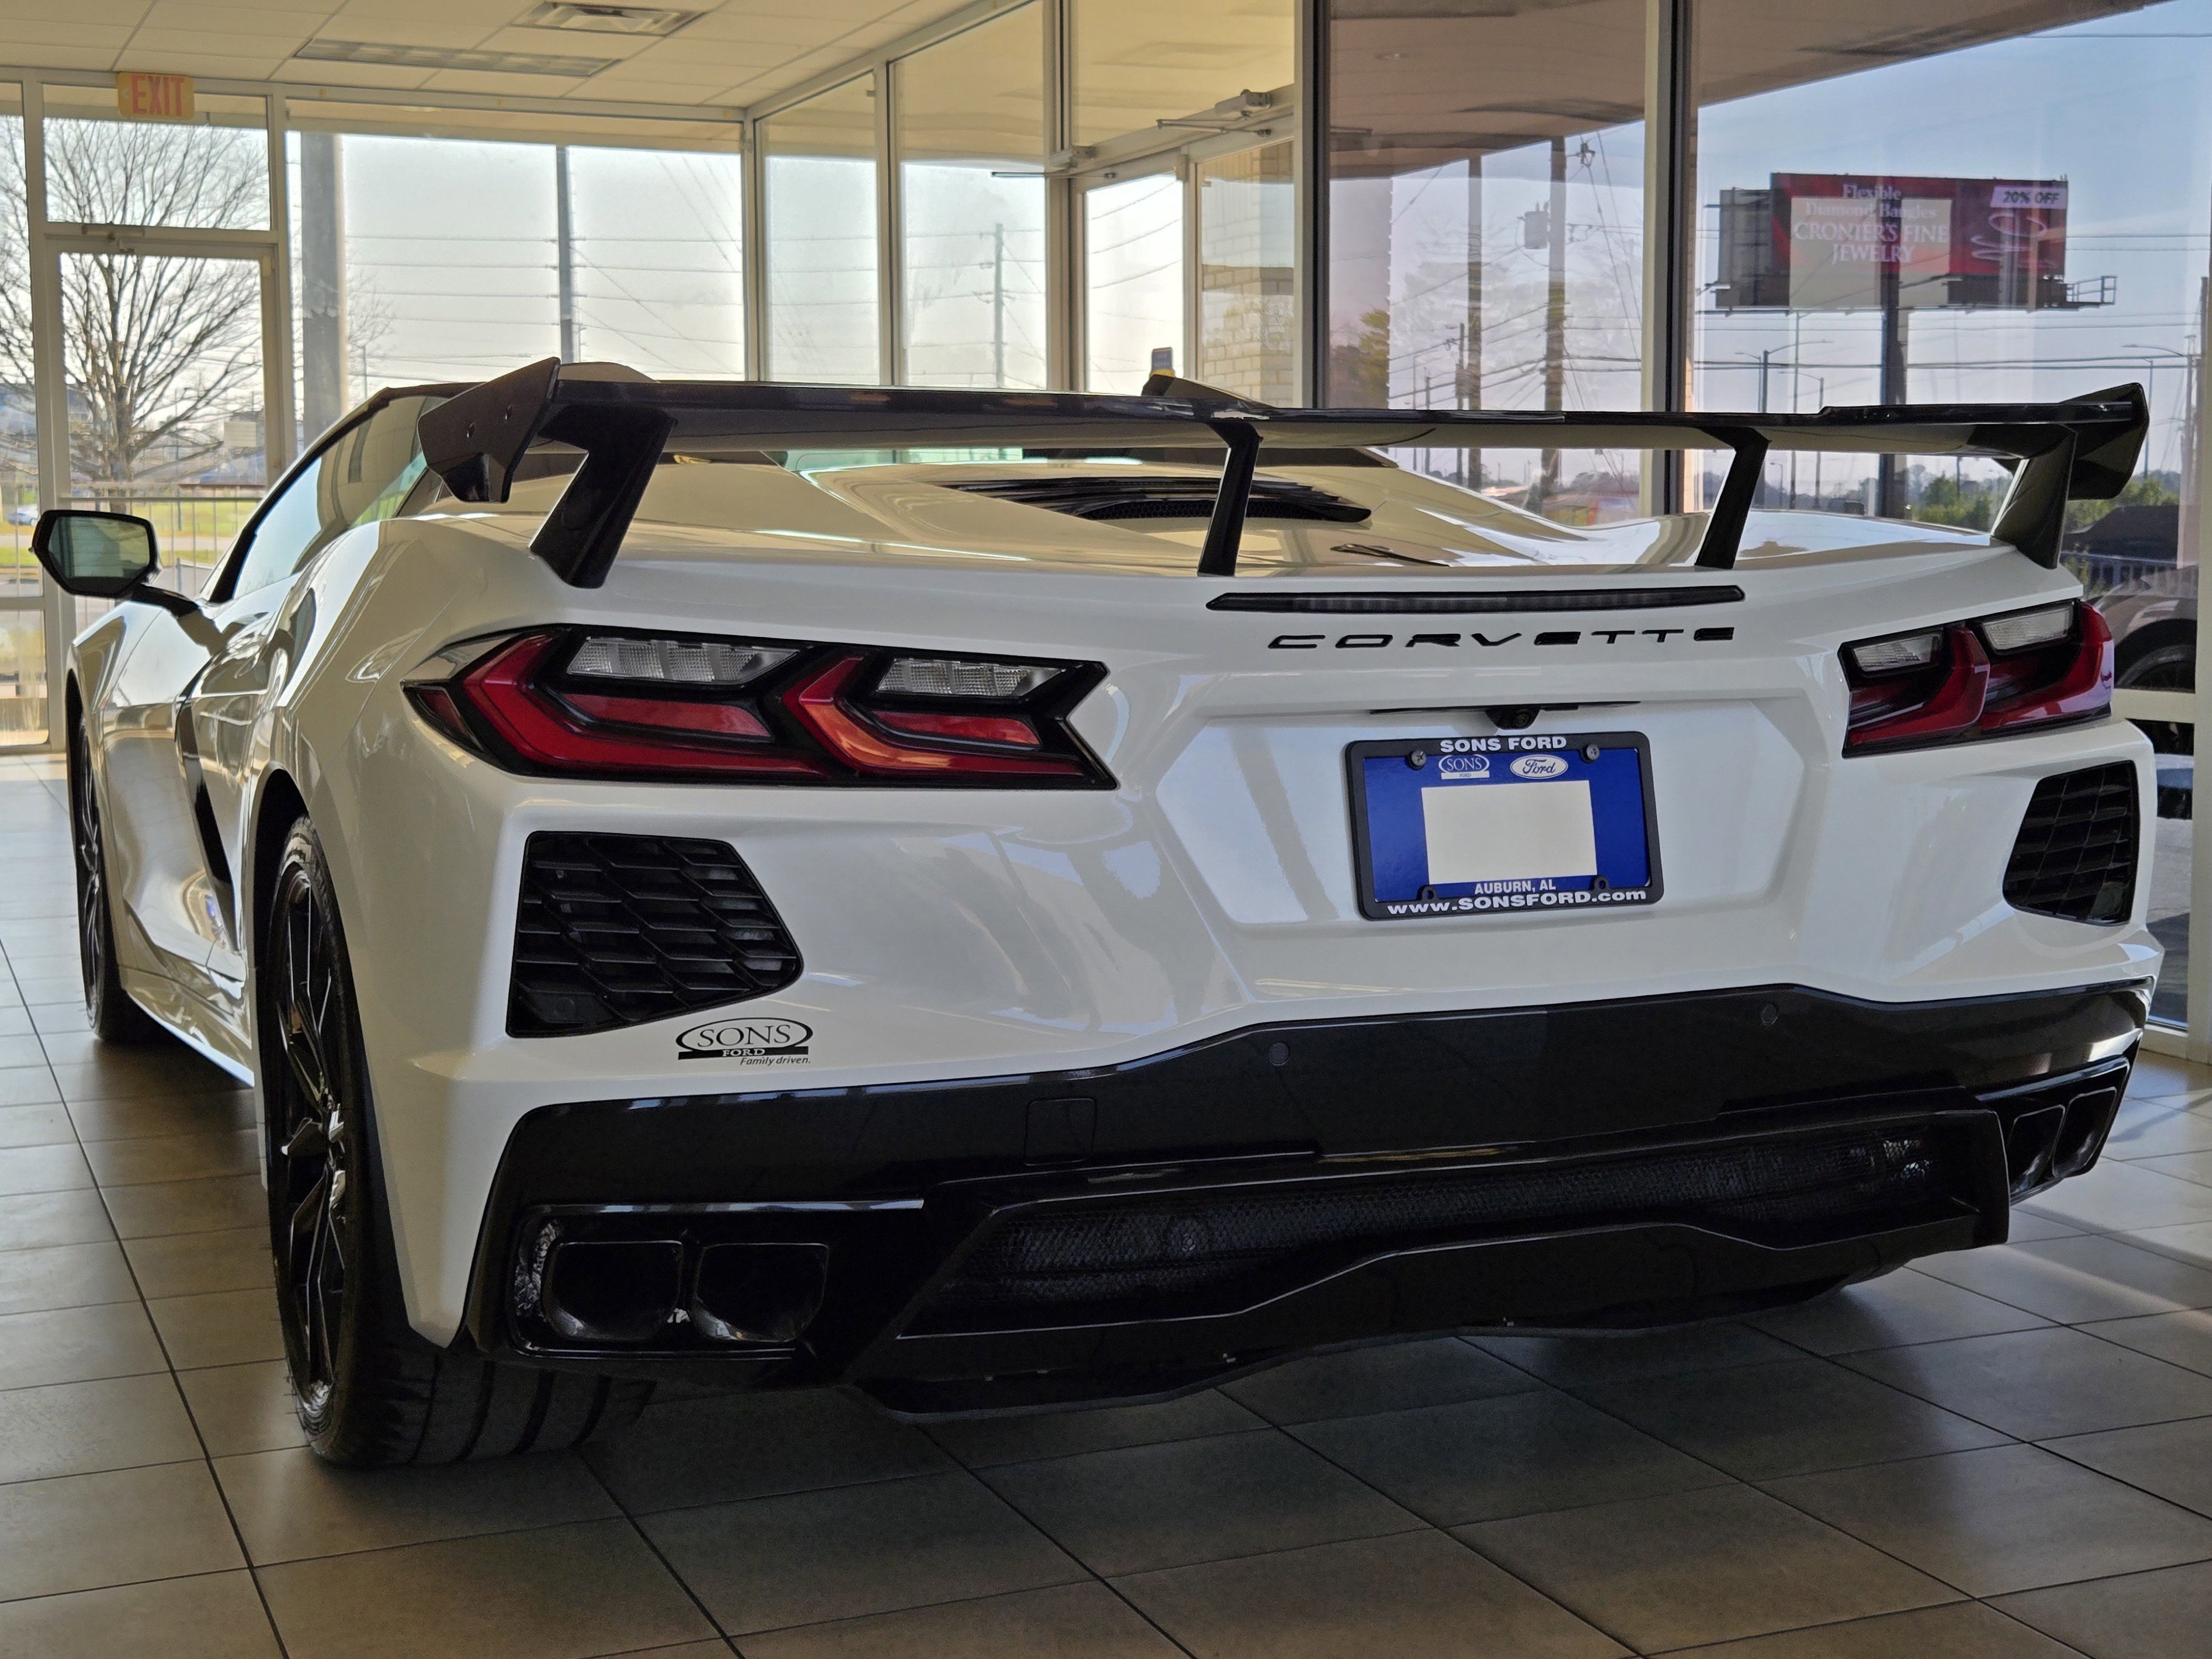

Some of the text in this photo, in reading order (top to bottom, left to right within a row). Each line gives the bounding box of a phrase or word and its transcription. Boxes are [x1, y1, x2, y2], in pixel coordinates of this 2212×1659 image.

[130, 74, 185, 116] EXIT
[1843, 184, 1902, 200] Flexible
[2002, 190, 2060, 204] 20% OFF
[1806, 202, 1875, 216] Diamond
[1903, 225, 1948, 243] FINE
[1833, 243, 1916, 263] JEWELRY
[1267, 627, 1735, 649] CORVETTE
[1440, 736, 1567, 753] SONS FORD
[1447, 757, 1482, 771] SONS
[1522, 759, 1556, 774] Ford
[1474, 879, 1556, 895] AUBURN, AL
[1387, 890, 1646, 915] www.SONSFORD.com
[697, 1024, 791, 1047] SONS
[722, 1047, 765, 1057] FORD
[739, 1056, 811, 1066] Family driven.
